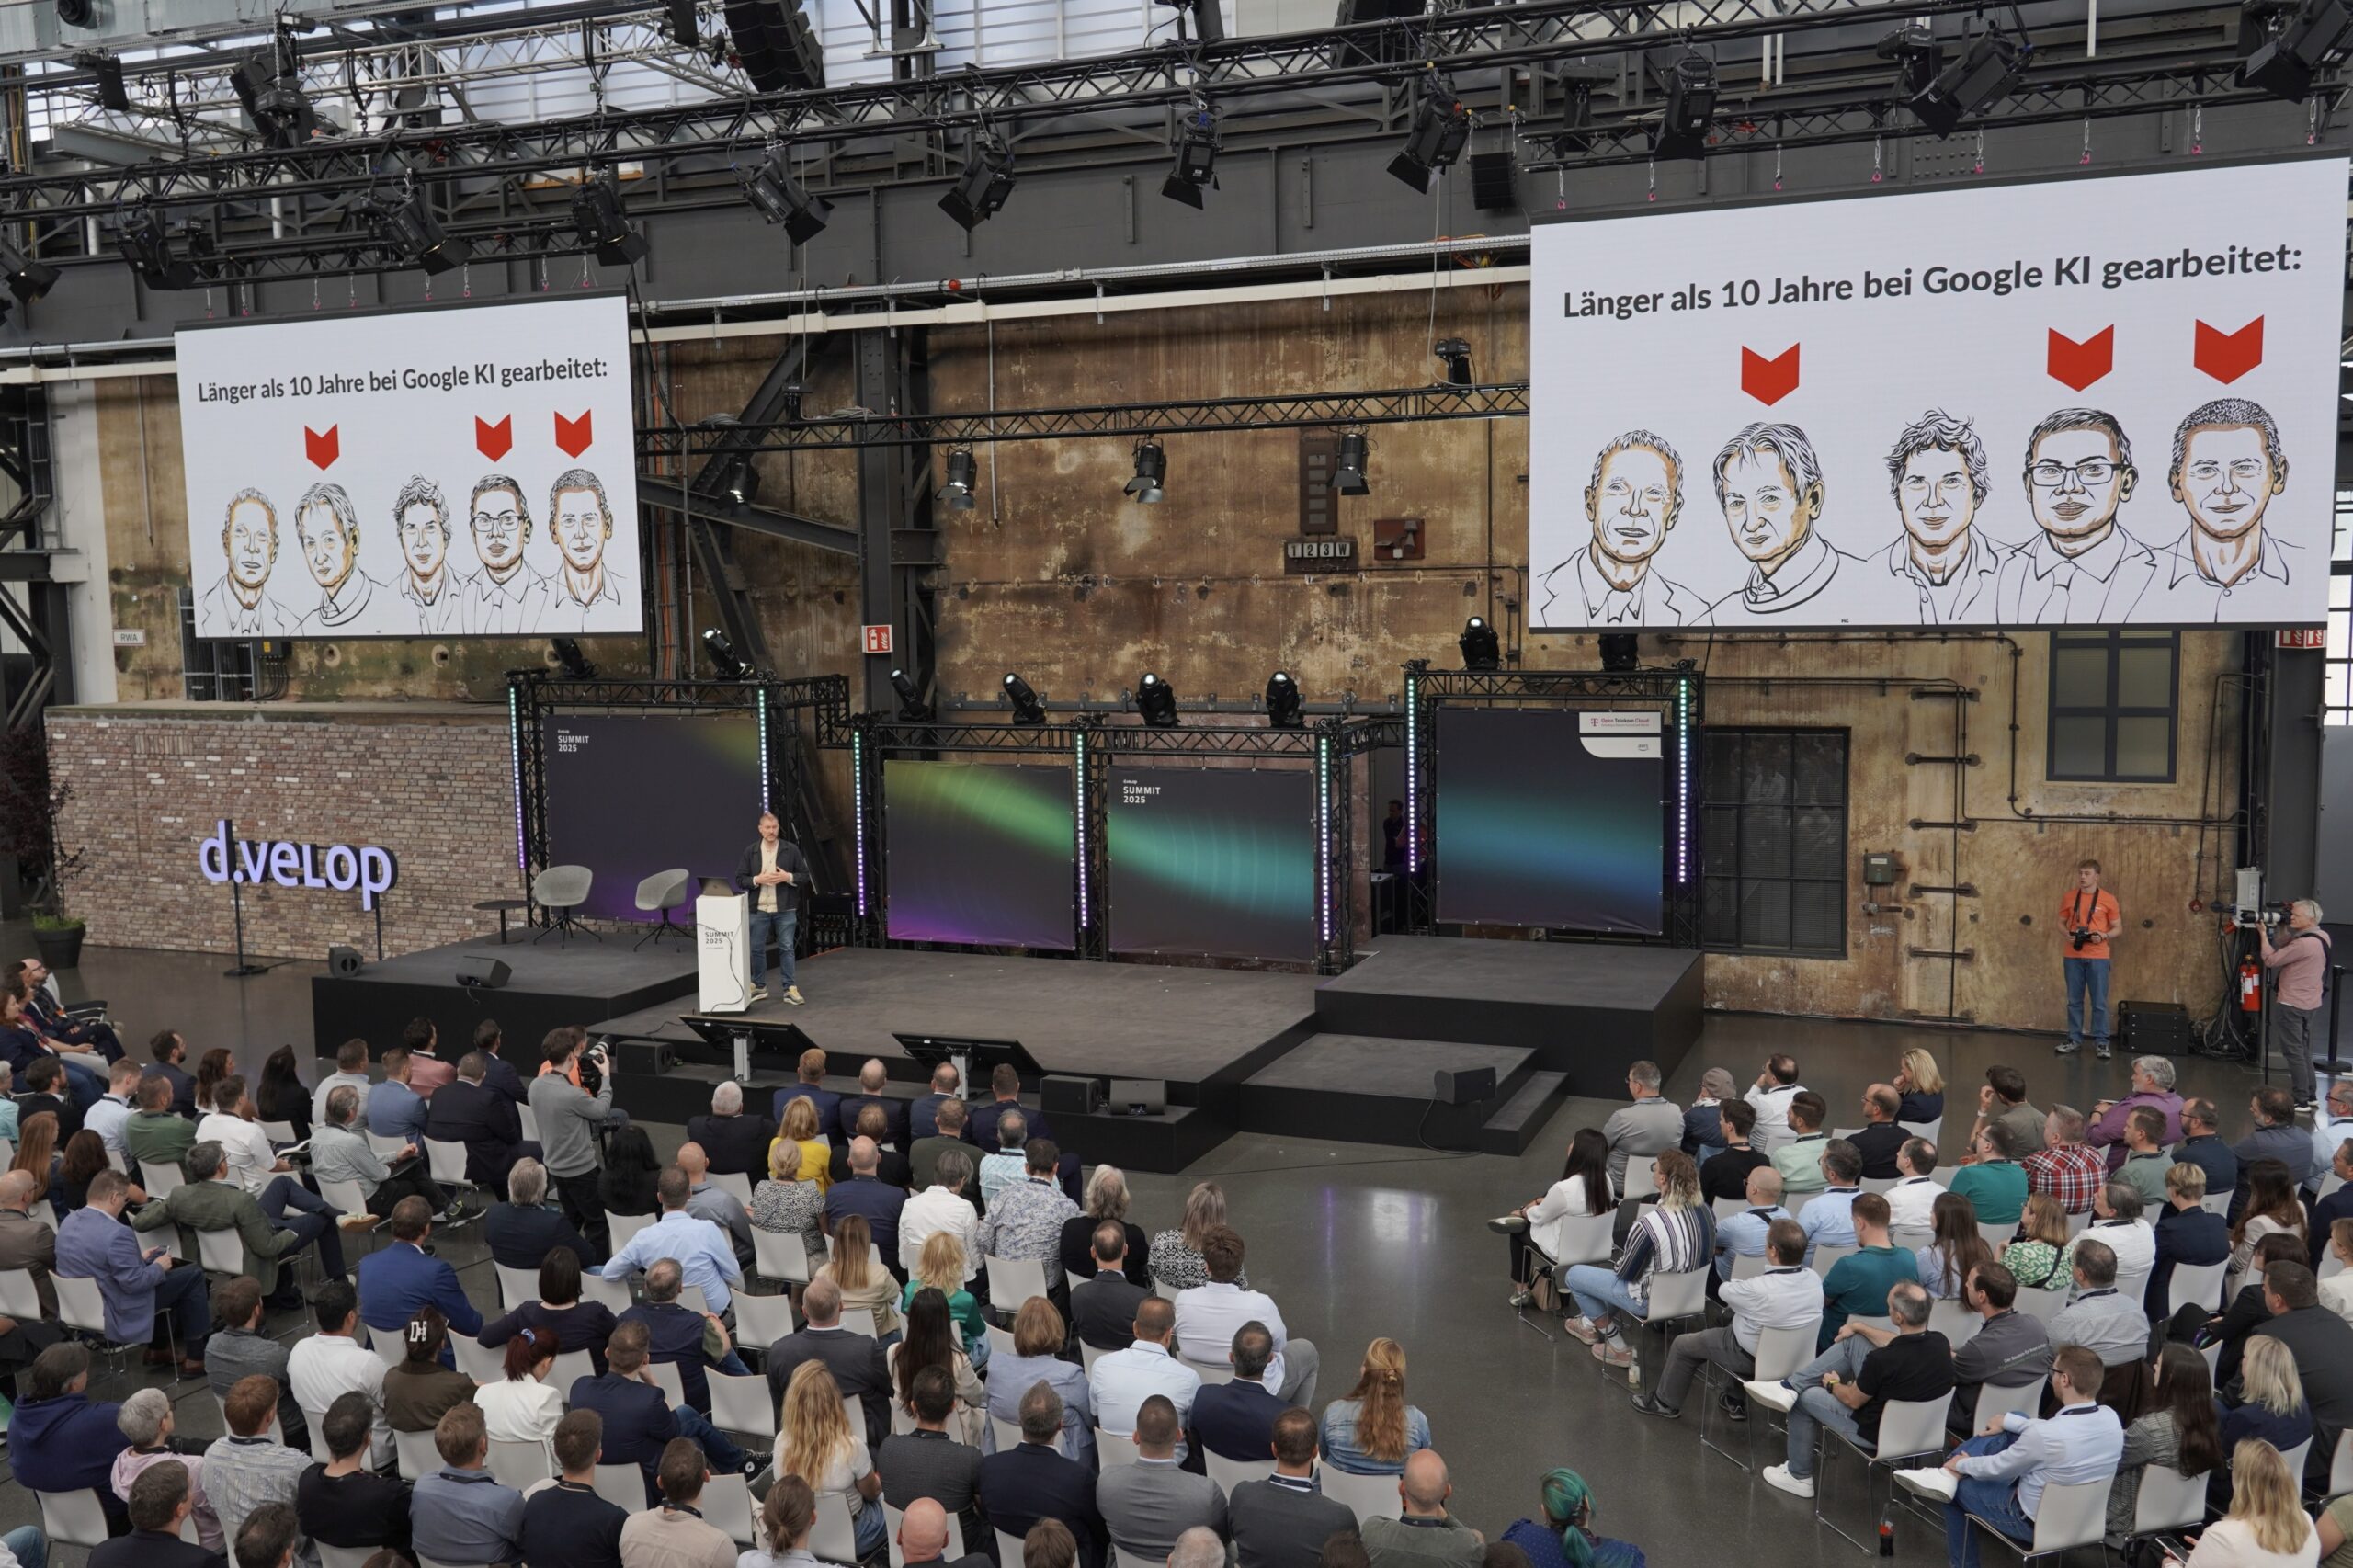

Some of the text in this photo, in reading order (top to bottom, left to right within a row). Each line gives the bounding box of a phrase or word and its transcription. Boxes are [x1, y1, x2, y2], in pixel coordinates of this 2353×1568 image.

[1563, 244, 2302, 320] Länger als 10 Jahre bei Google KI gearbeitet:
[198, 358, 608, 404] Länger als 10 Jahre bei Google KI gearbeitet:
[120, 633, 138, 642] RWA
[557, 735, 589, 744] SUMMIT
[558, 744, 577, 752] 2025
[1123, 786, 1161, 795] SUMMIT
[1123, 795, 1146, 804] 2025
